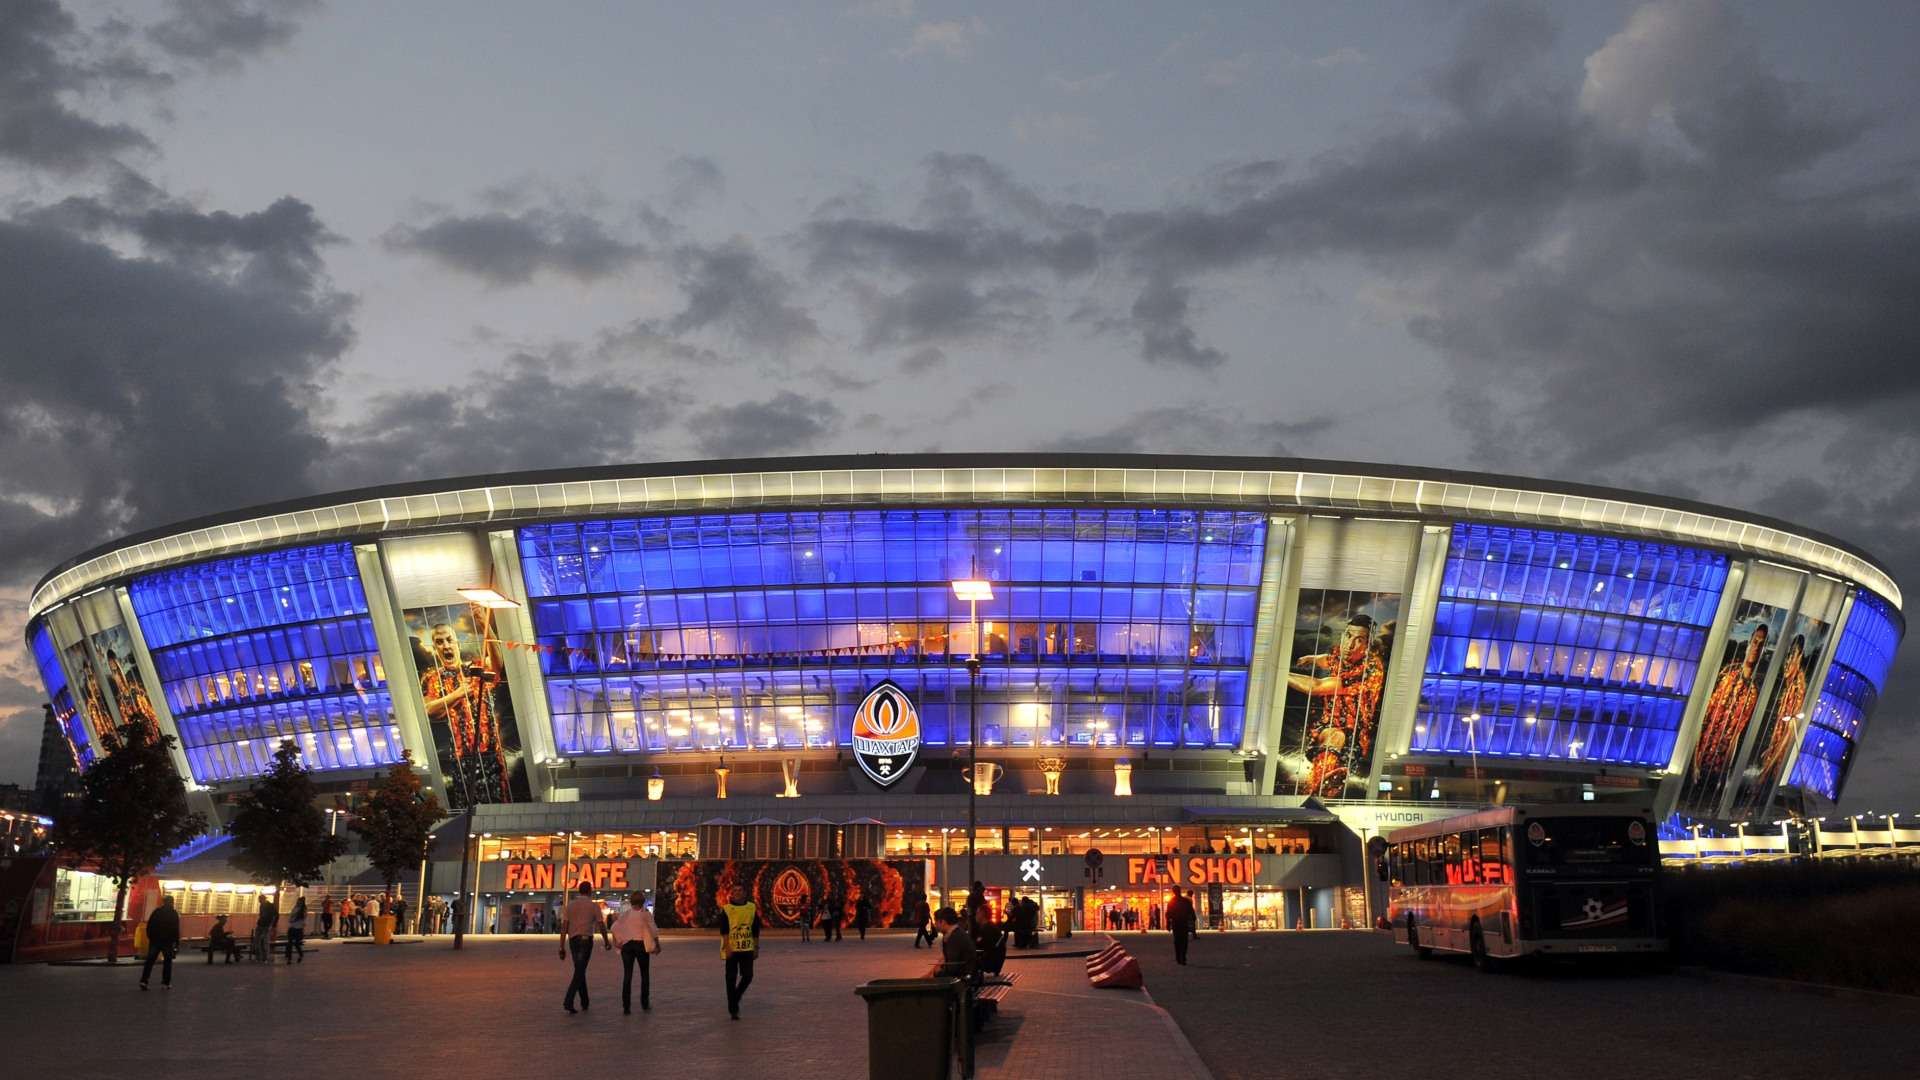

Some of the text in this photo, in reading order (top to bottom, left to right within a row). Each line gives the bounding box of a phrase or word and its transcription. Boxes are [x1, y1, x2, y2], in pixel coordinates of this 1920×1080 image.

[856, 738, 918, 754] ШАХТАР
[1375, 812, 1424, 822] HYUNDAI
[505, 861, 628, 890] FAN CAFE
[1128, 857, 1181, 884] FAN
[1188, 856, 1262, 884] SHOP
